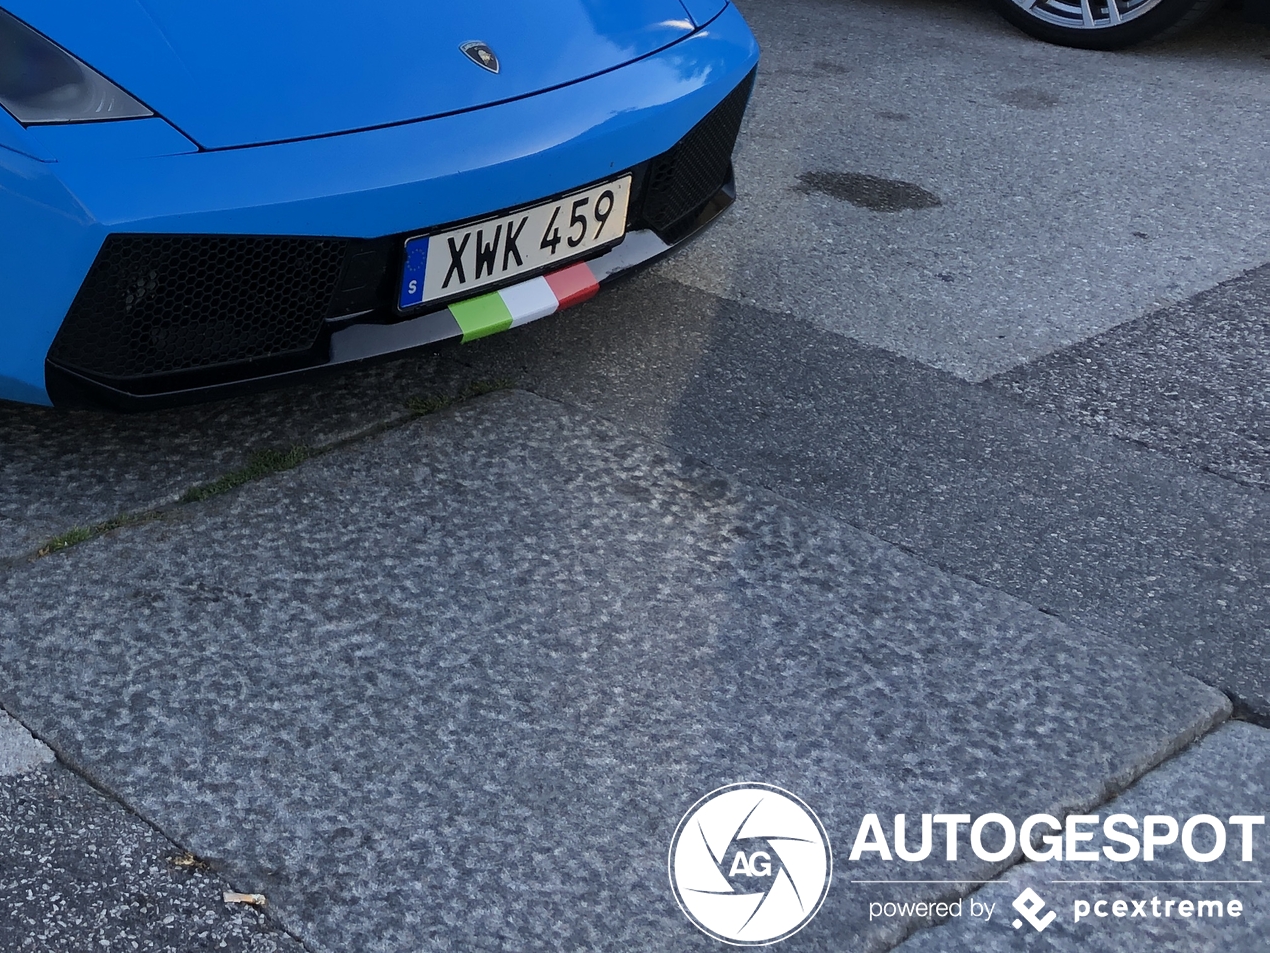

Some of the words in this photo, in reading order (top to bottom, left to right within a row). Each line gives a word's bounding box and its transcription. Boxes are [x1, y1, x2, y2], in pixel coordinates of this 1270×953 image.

[441, 216, 529, 289] XWK
[539, 189, 615, 255] 459
[407, 279, 418, 295] S
